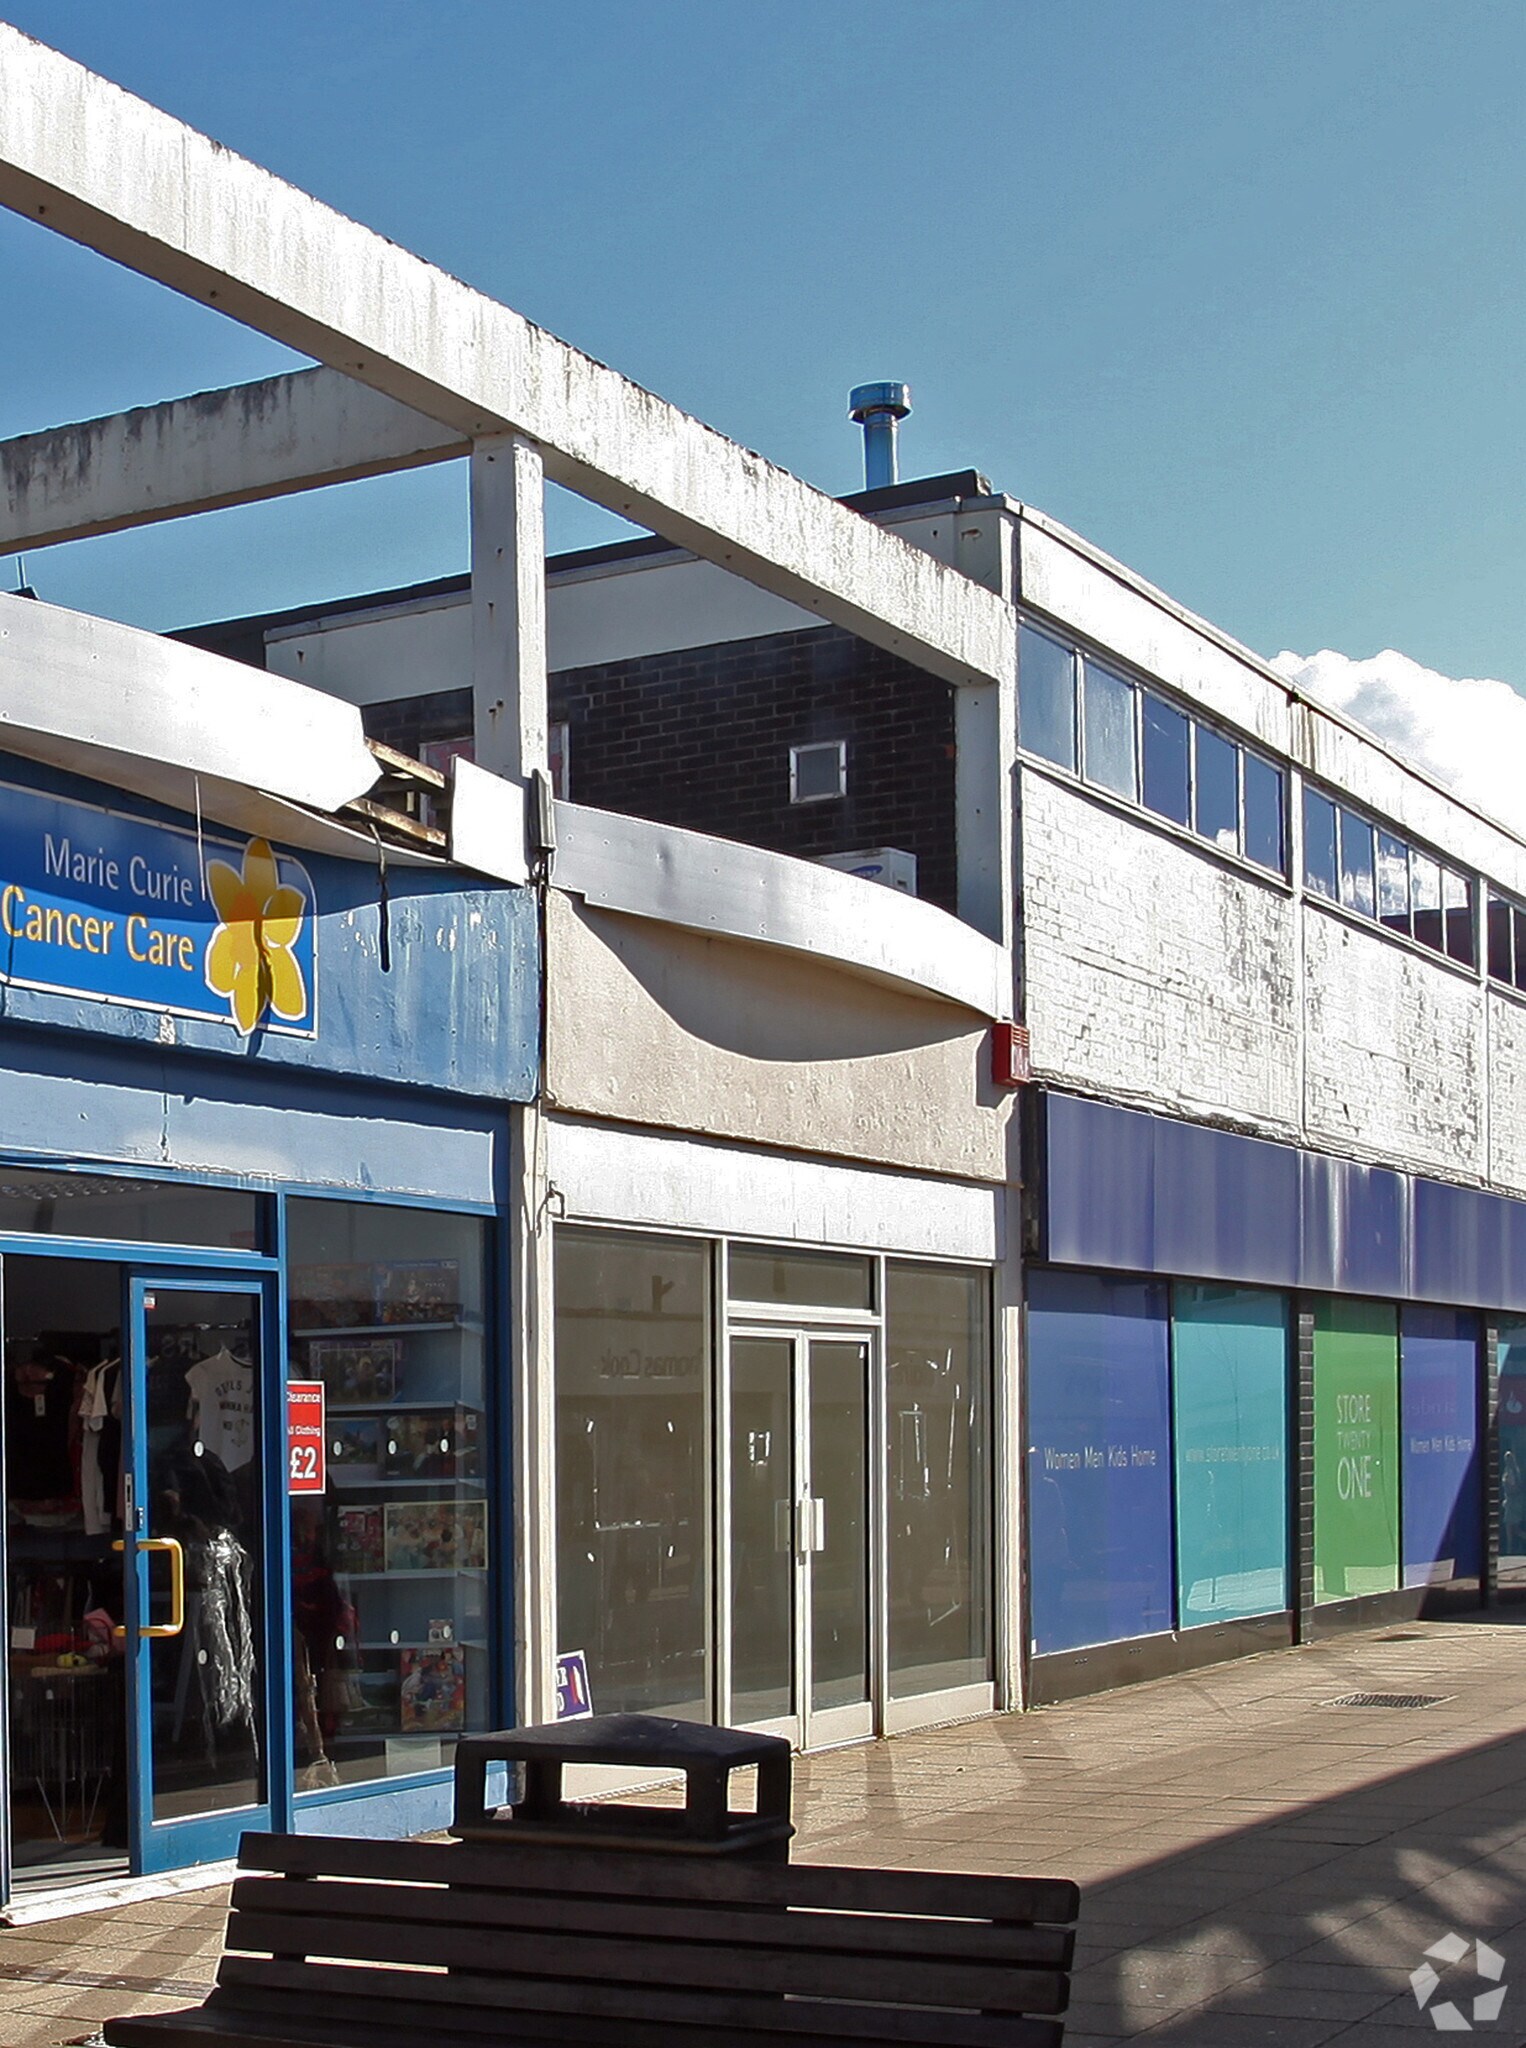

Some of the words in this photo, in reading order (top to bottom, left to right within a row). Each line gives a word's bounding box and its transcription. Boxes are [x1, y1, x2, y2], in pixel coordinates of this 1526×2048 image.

[44, 833, 119, 890] Marie
[129, 855, 193, 907] Curie
[2, 884, 114, 955] Cancer
[126, 914, 194, 972] Care
[1336, 1394, 1371, 1423] STORE
[1044, 1447, 1081, 1469] Women
[1084, 1446, 1104, 1468] Men
[1108, 1445, 1127, 1467] Kids
[1131, 1445, 1156, 1467] Home
[1337, 1430, 1370, 1451] TWENTY
[289, 1446, 317, 1479] £2
[1337, 1455, 1372, 1501] ONE
